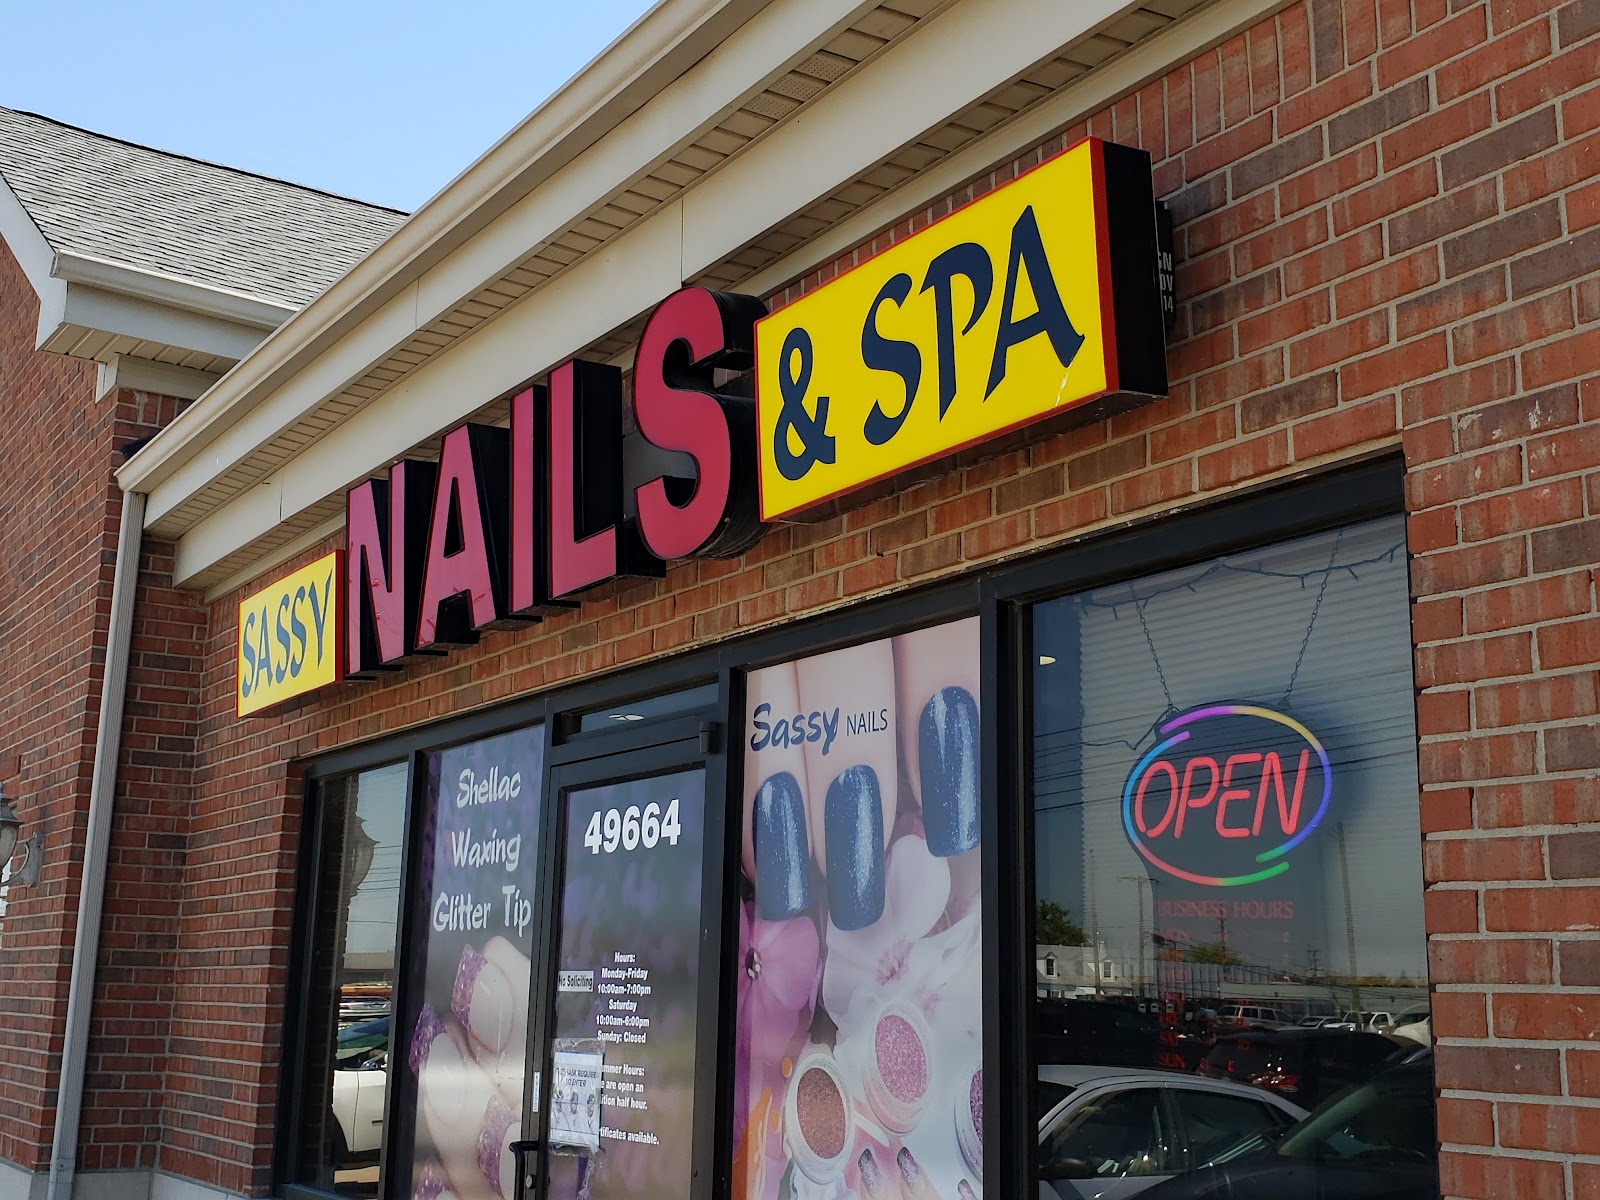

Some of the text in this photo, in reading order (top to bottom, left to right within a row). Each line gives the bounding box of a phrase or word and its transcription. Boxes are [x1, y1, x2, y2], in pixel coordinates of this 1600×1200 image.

[242, 205, 1086, 698] SASSY NAILS & SPA
[751, 703, 888, 756] Sassy NAILS
[457, 766, 521, 808] Shellac
[1135, 749, 1310, 839] OPEN
[584, 799, 681, 854] 49664
[452, 828, 521, 872] Waxing
[433, 885, 532, 937] Glitter Tip
[1234, 900, 1294, 919] HOURS
[614, 952, 636, 963] Hours:
[567, 974, 593, 990] Soliciting
[601, 968, 648, 980] Monday-Friday
[597, 984, 651, 996] 10:00am-7:00pm
[608, 999, 637, 1012] Saturday
[597, 1030, 646, 1043] Sunday: Closed
[602, 1064, 645, 1077] mmer Hours:
[606, 1081, 617, 1090] are
[618, 1082, 634, 1093] open
[635, 1083, 644, 1093] an
[601, 1094, 648, 1110] ition half hour.
[600, 1126, 660, 1145] tificates available.
